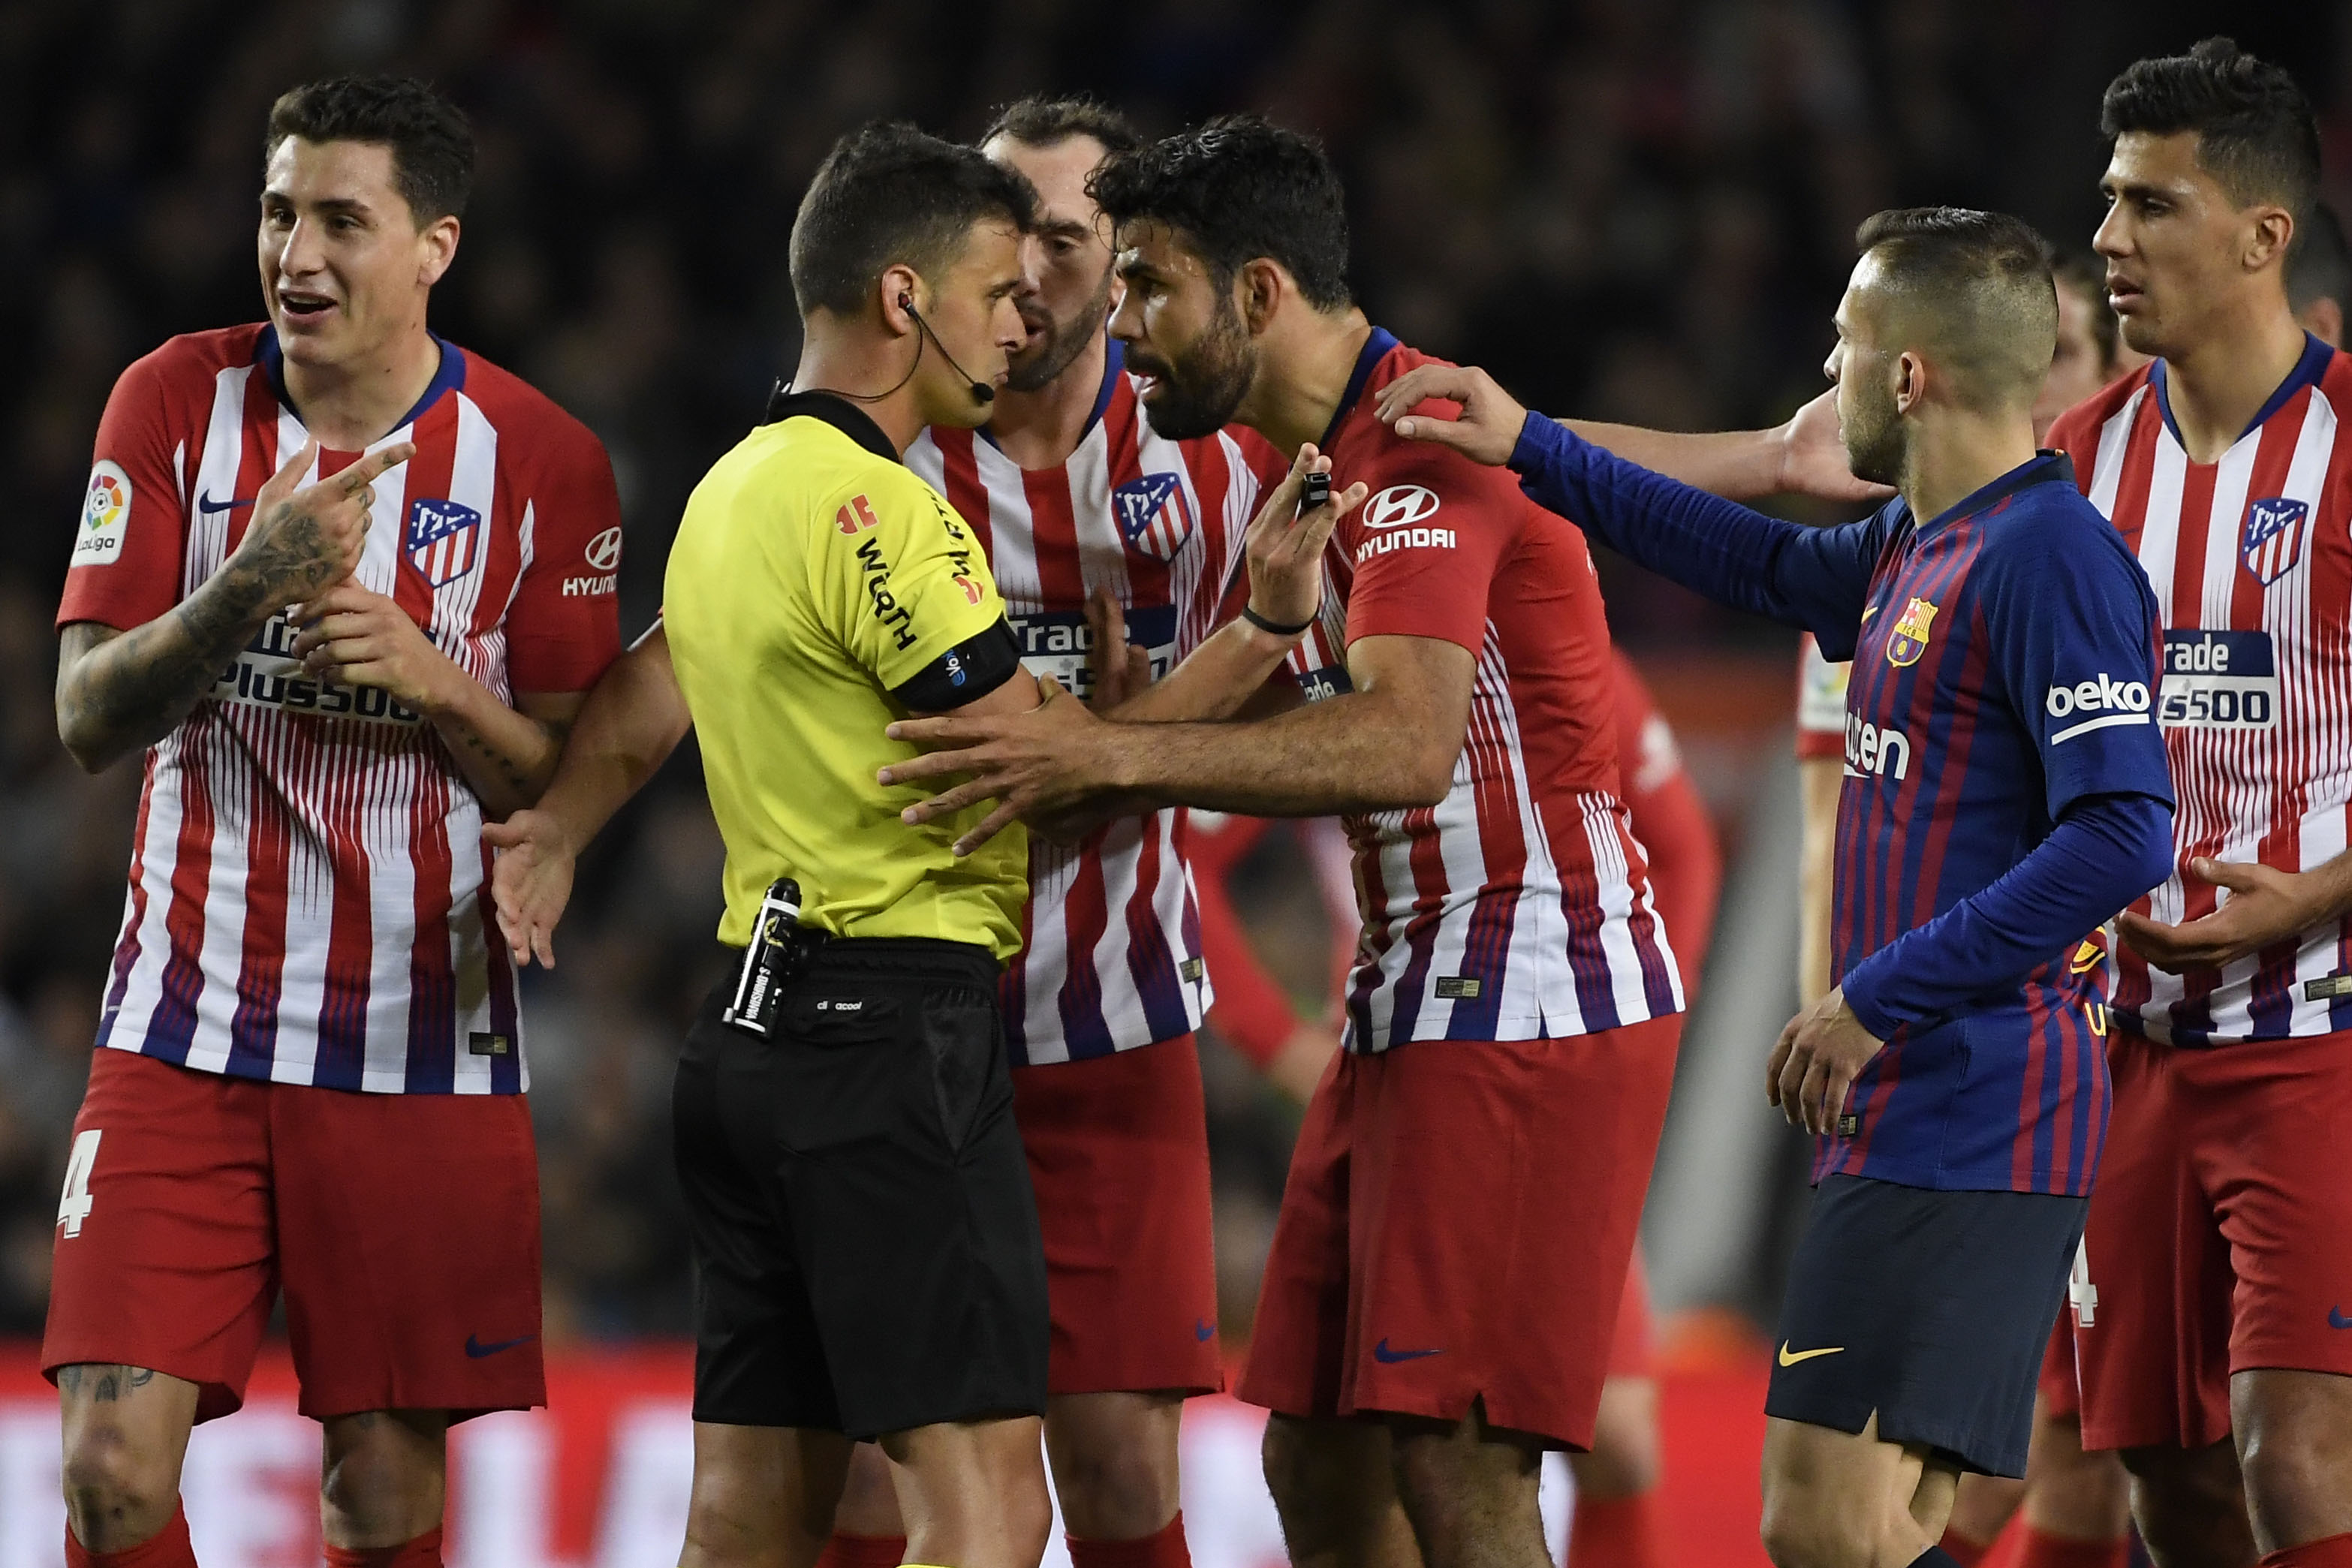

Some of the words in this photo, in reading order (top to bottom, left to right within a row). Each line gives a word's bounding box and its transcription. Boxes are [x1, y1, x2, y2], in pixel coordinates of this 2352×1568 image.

[1355, 528, 1456, 563] HYUNDAI
[2046, 673, 2151, 718] beko
[56, 1129, 102, 1238] 4
